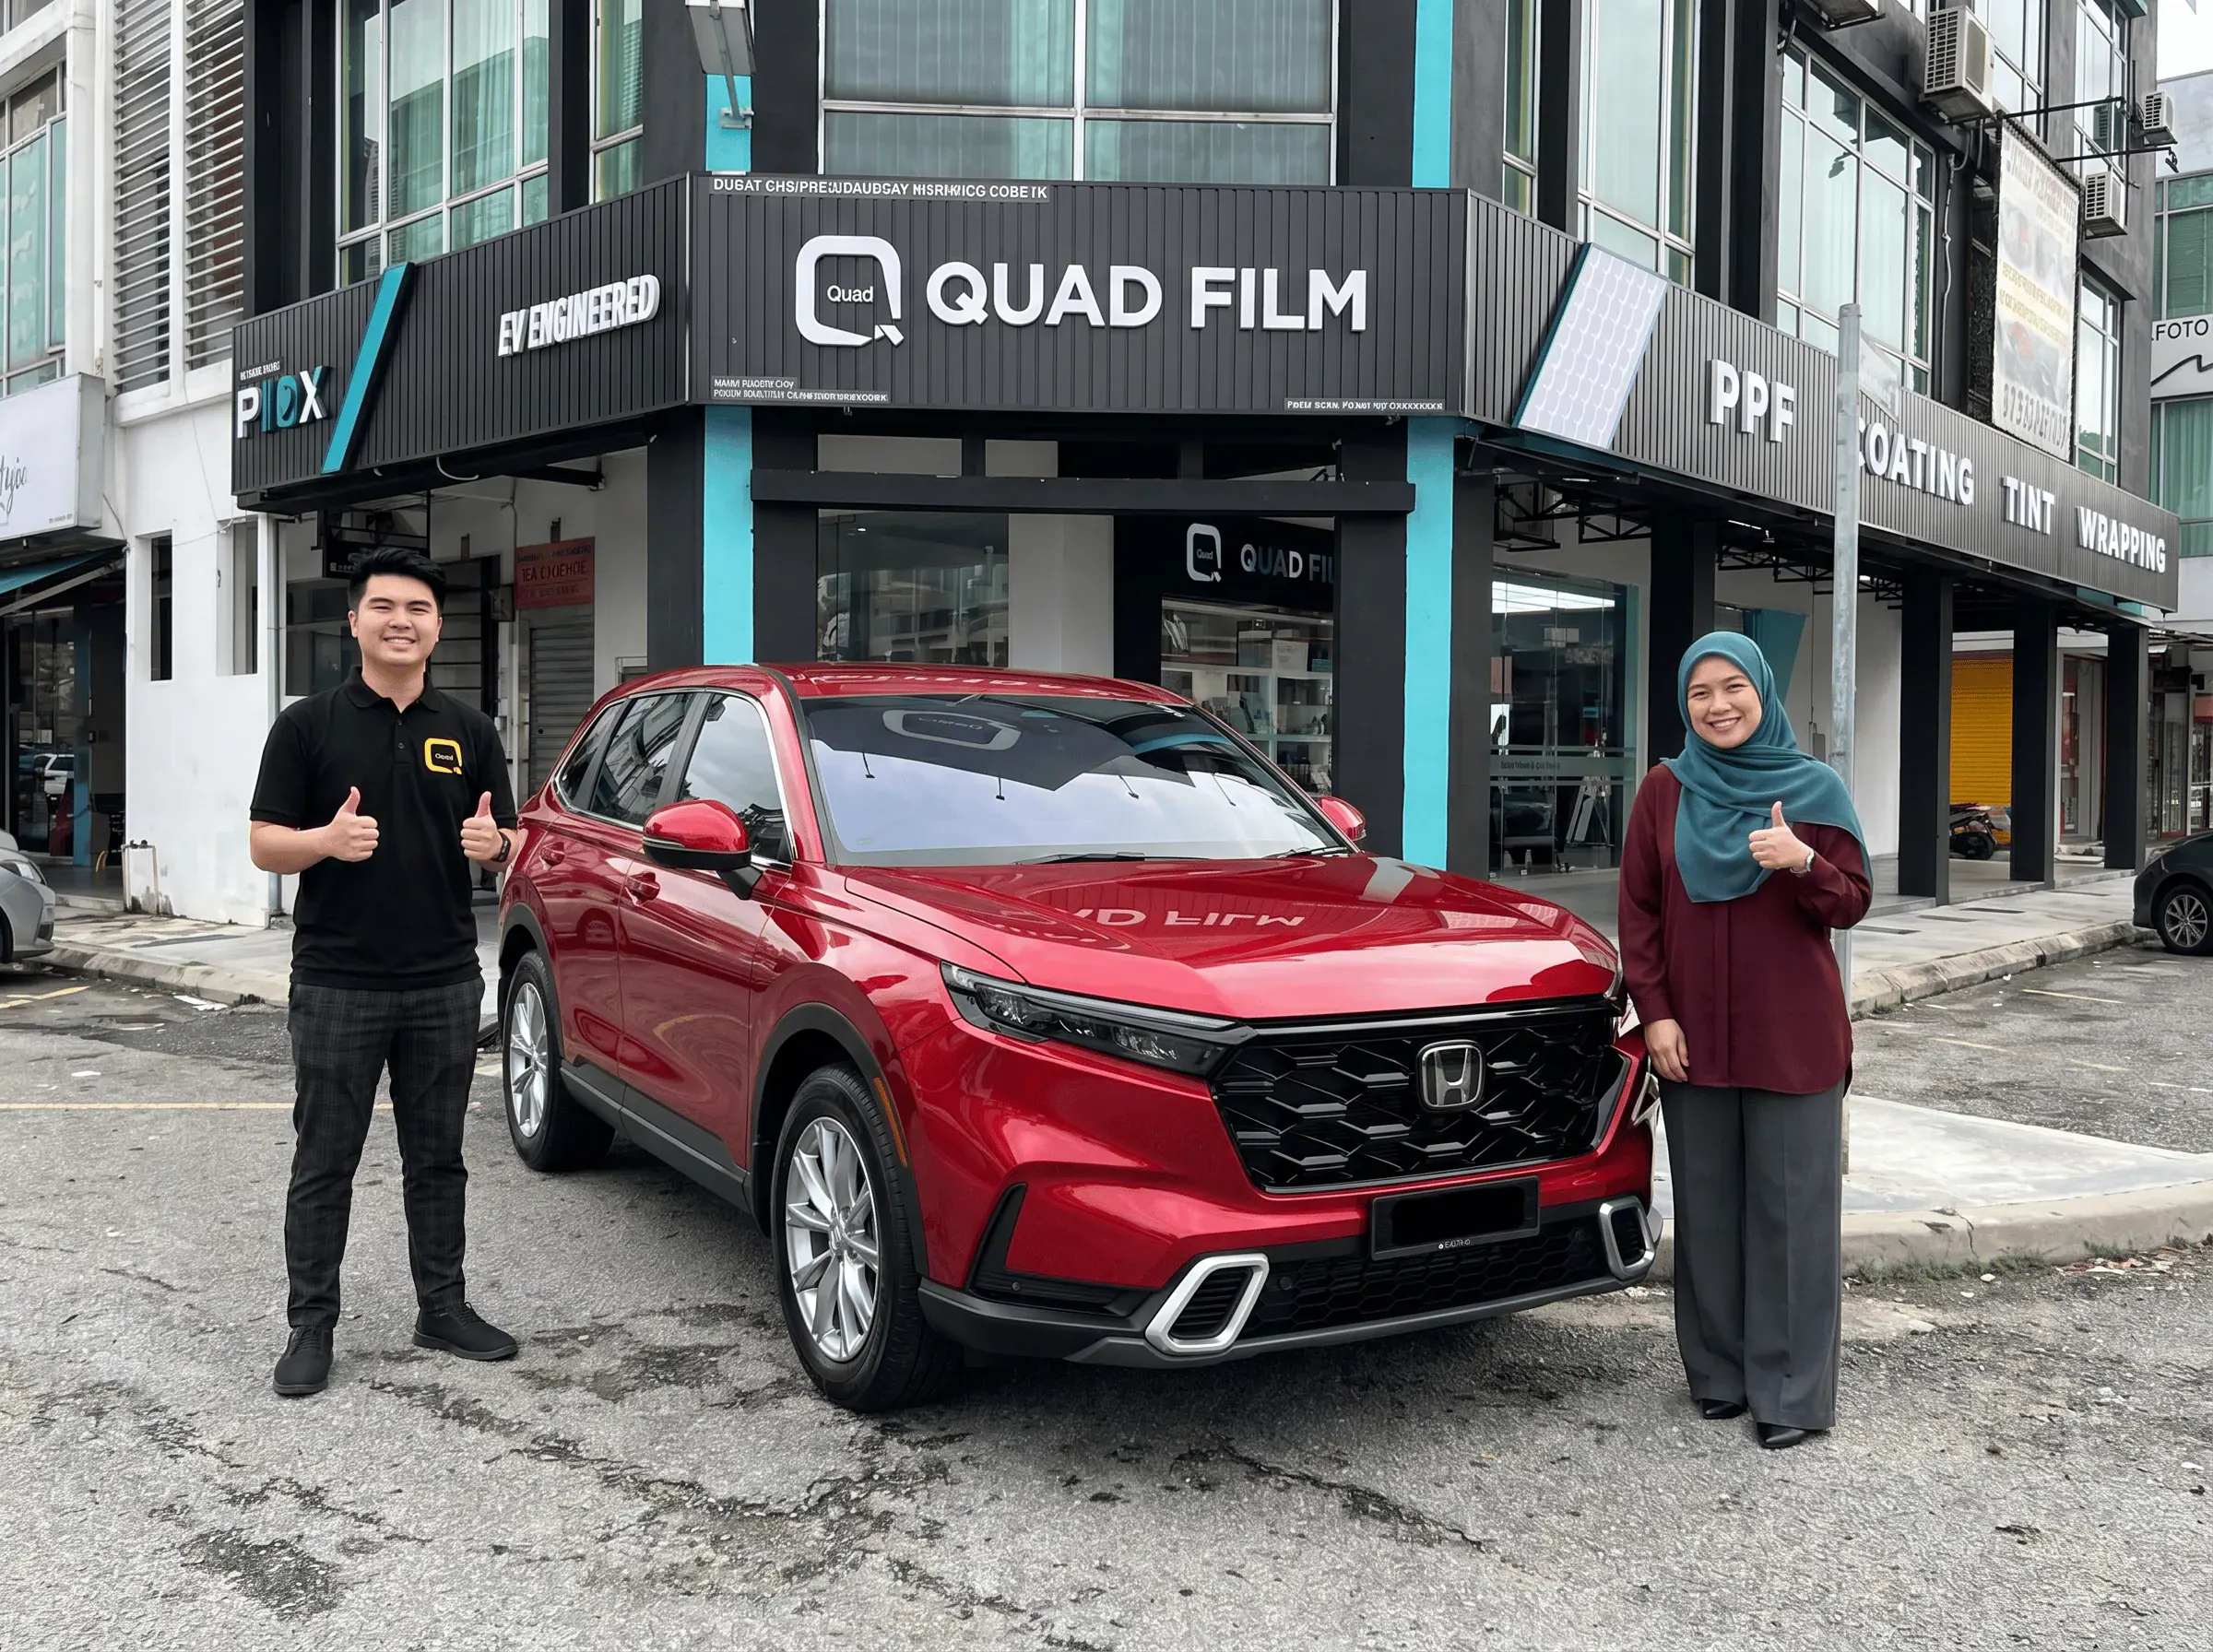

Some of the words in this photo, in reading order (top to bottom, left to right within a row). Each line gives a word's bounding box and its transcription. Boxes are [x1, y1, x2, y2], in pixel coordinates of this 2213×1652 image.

[498, 309, 528, 357] EV
[527, 274, 660, 350] ENGINEERED
[826, 285, 874, 303] Quad
[926, 261, 1163, 328] QUAD
[1190, 266, 1367, 333] FILM
[2151, 318, 2209, 341] FOTO
[1709, 359, 1794, 442] PPF
[2001, 475, 2054, 535] TINT
[2076, 505, 2166, 573] WRAPPING
[1240, 544, 1303, 579] QUAD
